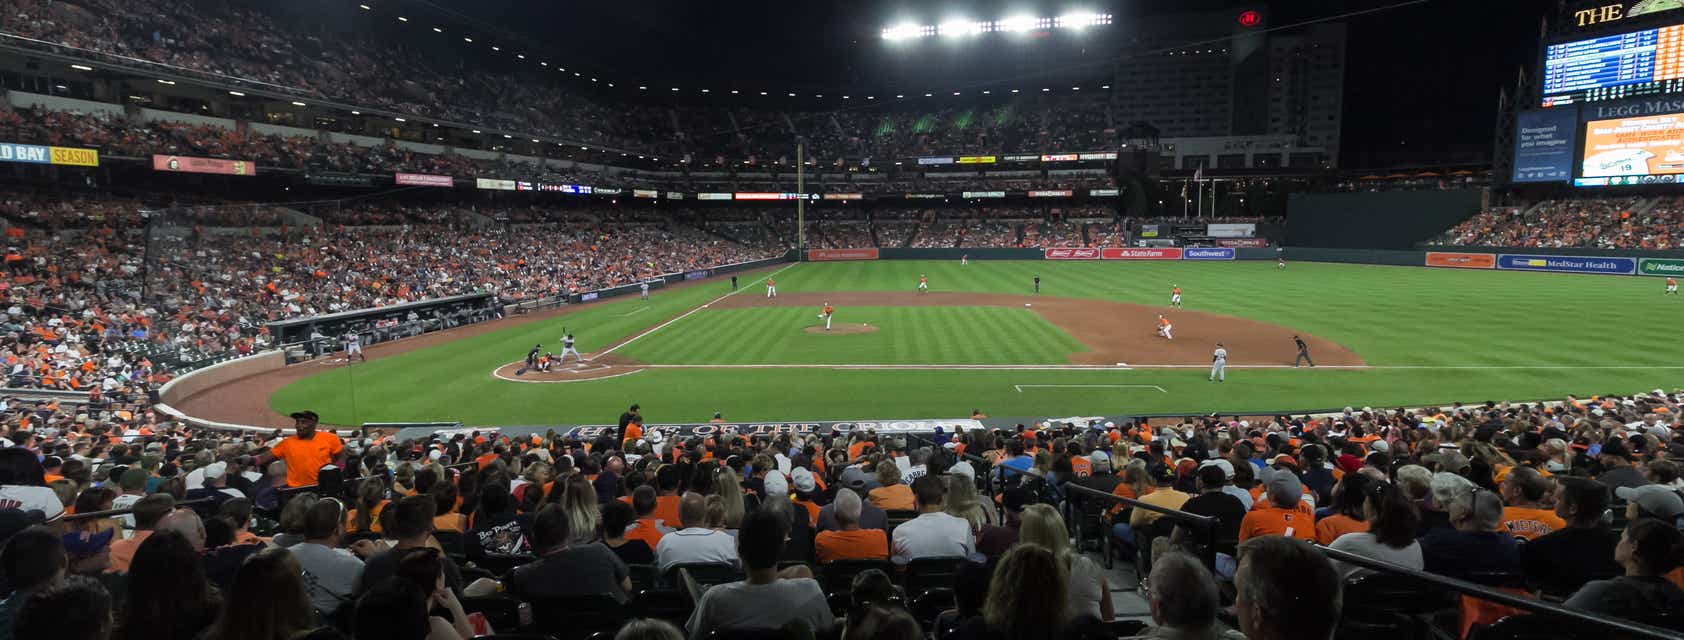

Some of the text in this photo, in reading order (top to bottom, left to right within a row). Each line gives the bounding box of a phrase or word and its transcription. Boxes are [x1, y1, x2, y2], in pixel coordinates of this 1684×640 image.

[1575, 4, 1622, 26] THE
[1598, 104, 1640, 118] LEGG
[16, 146, 45, 161] BAY
[54, 149, 96, 165] SEASON
[1547, 260, 1584, 268] MedStar
[1585, 261, 1617, 270] Health
[748, 423, 820, 434] THE
